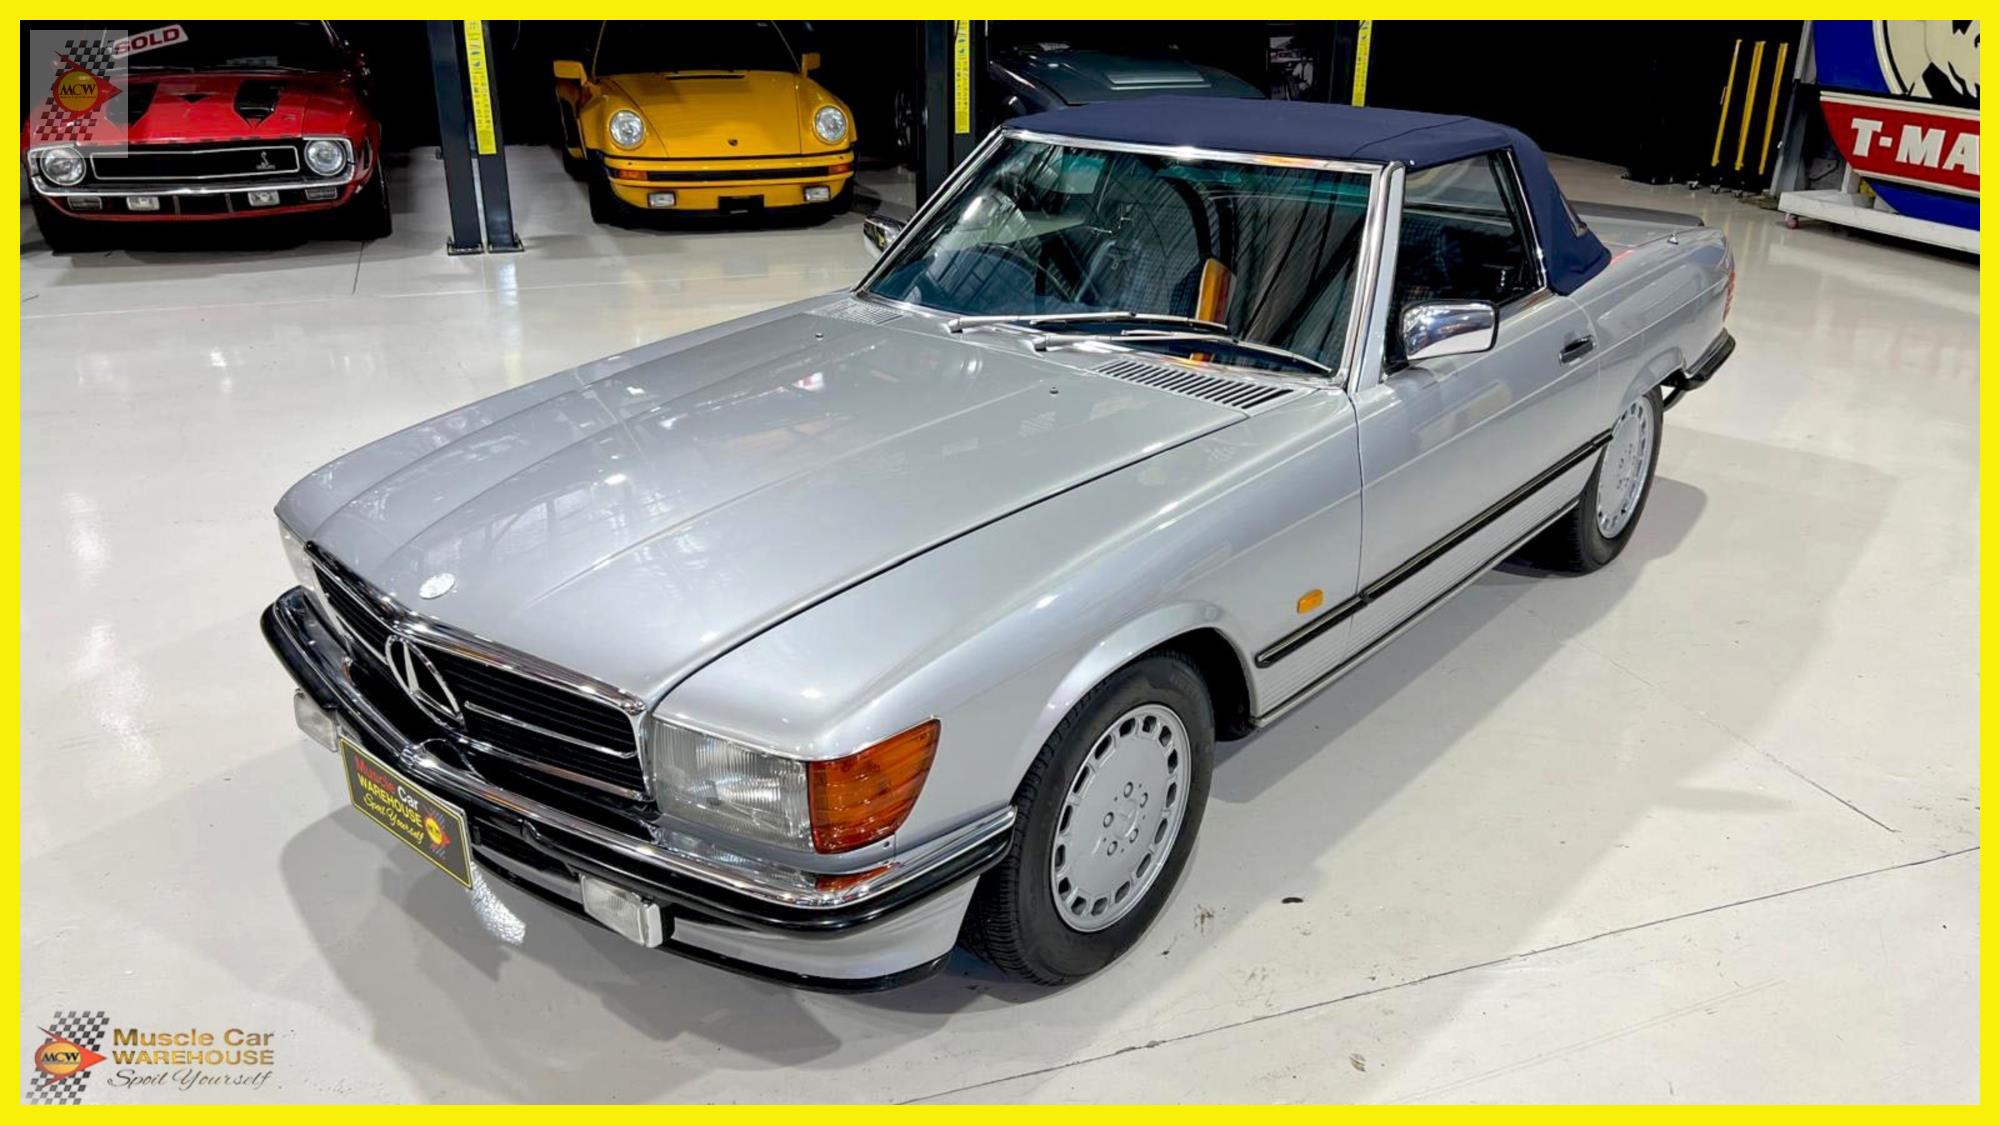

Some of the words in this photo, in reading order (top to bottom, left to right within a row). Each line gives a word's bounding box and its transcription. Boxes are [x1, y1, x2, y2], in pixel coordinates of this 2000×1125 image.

[114, 28, 180, 55] SOLD
[356, 771, 424, 828] WAREHOUSE
[397, 785, 419, 811] Car
